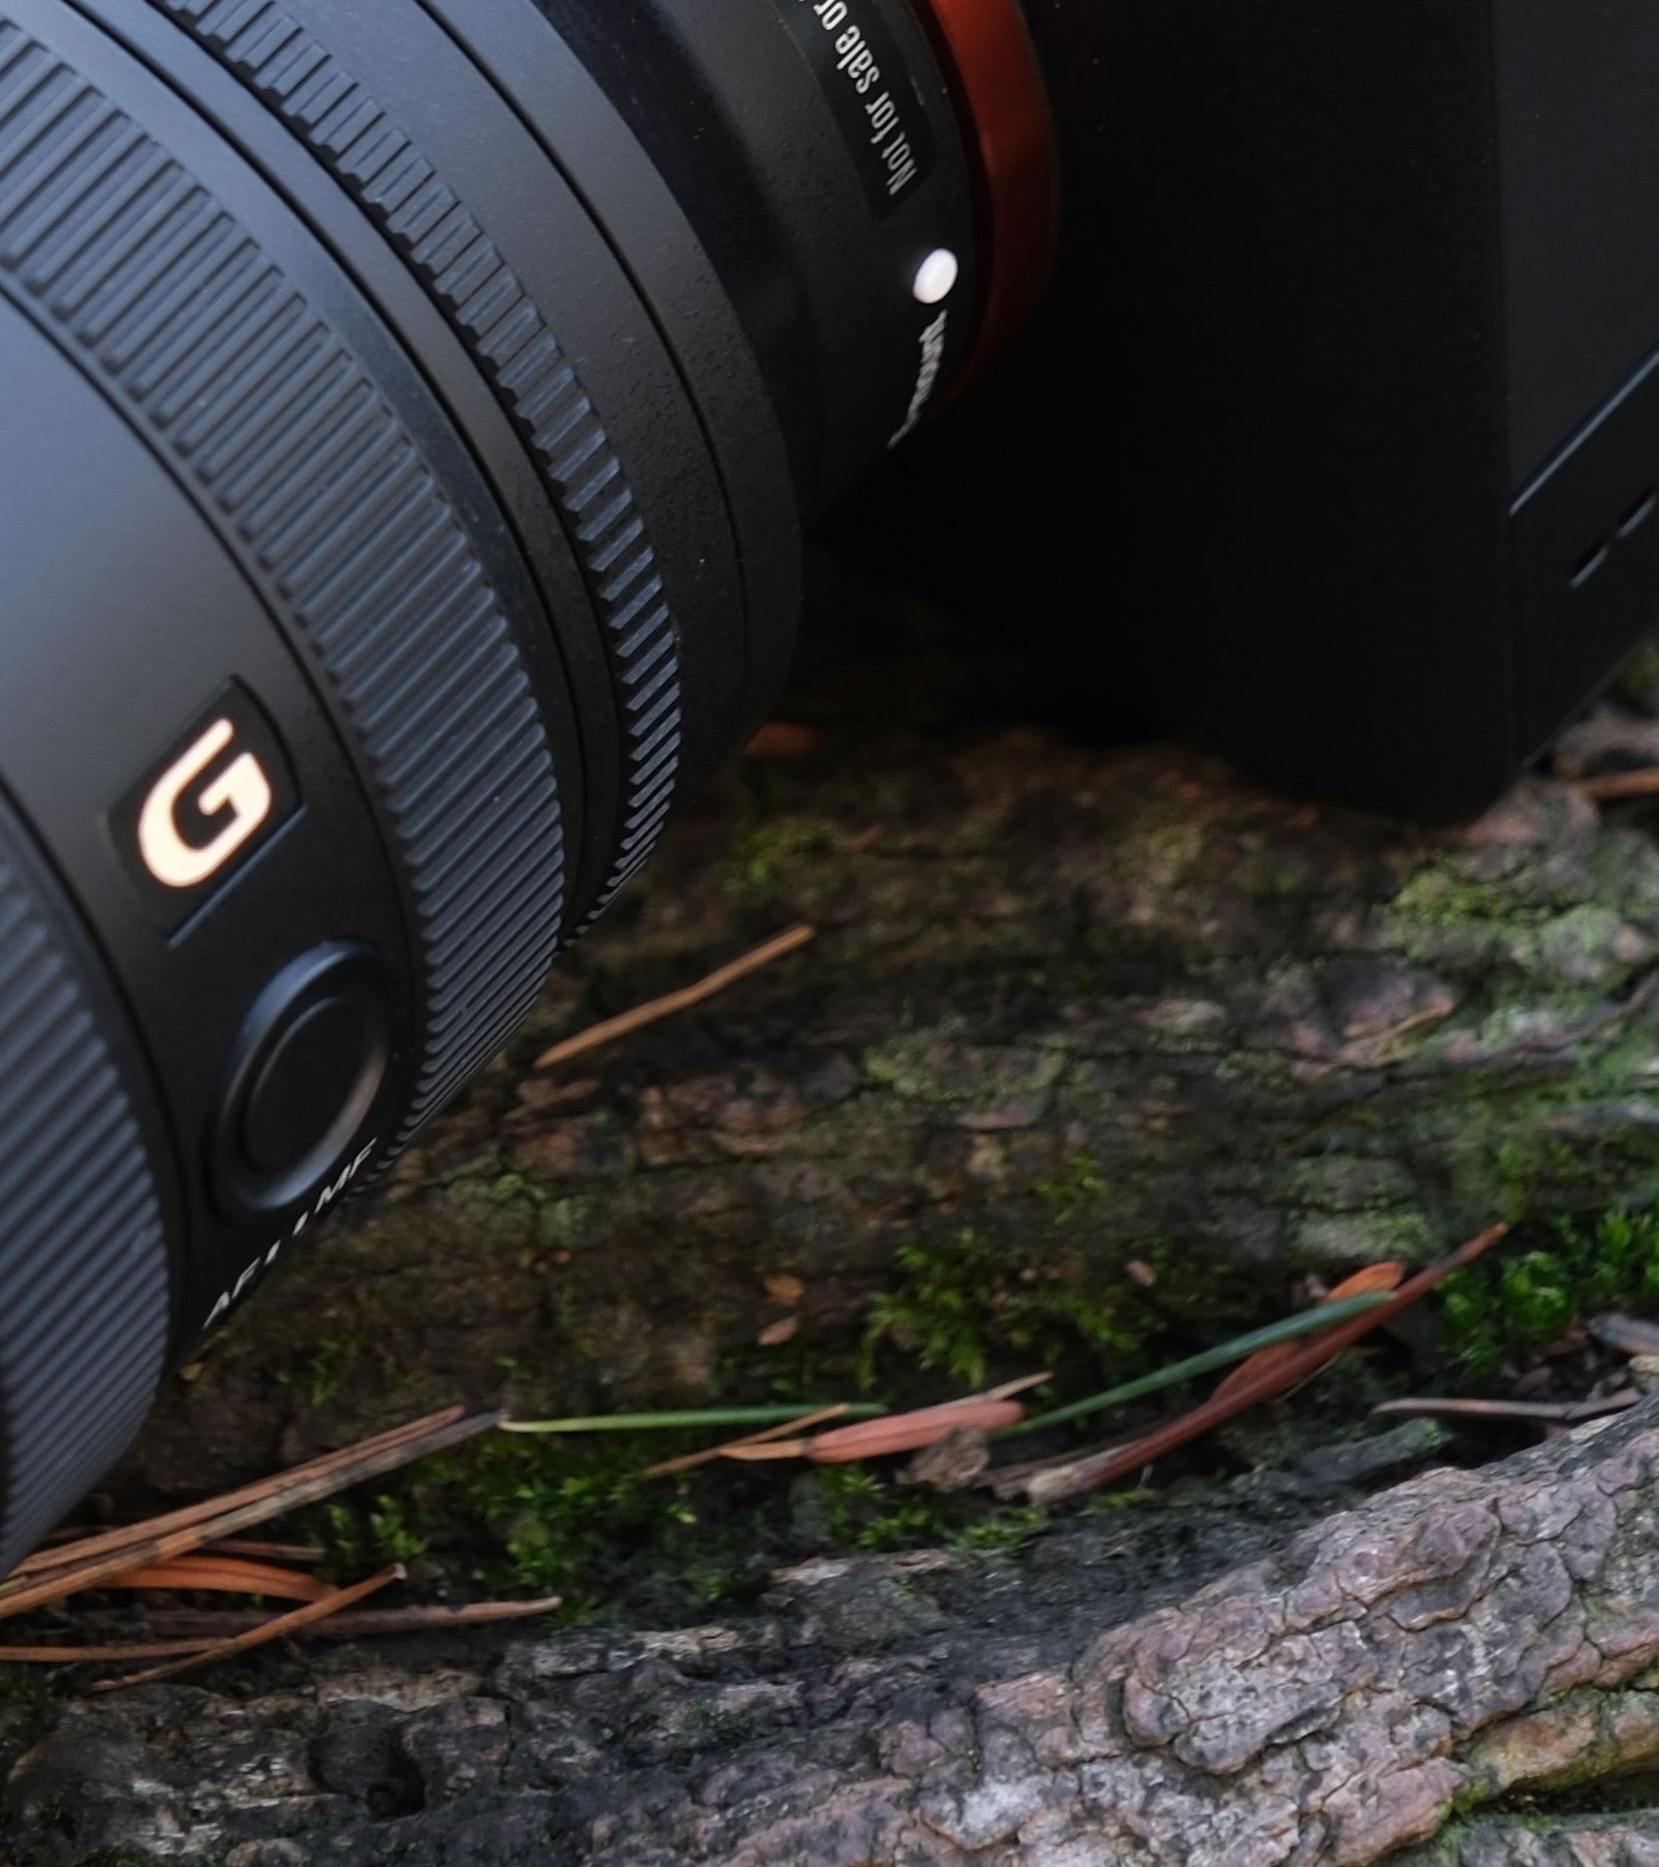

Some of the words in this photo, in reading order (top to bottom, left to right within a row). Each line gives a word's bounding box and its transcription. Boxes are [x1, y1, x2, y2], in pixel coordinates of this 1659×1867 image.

[834, 25, 881, 96] sale
[864, 90, 900, 145] for
[881, 131, 917, 196] Not
[139, 718, 271, 888] G
